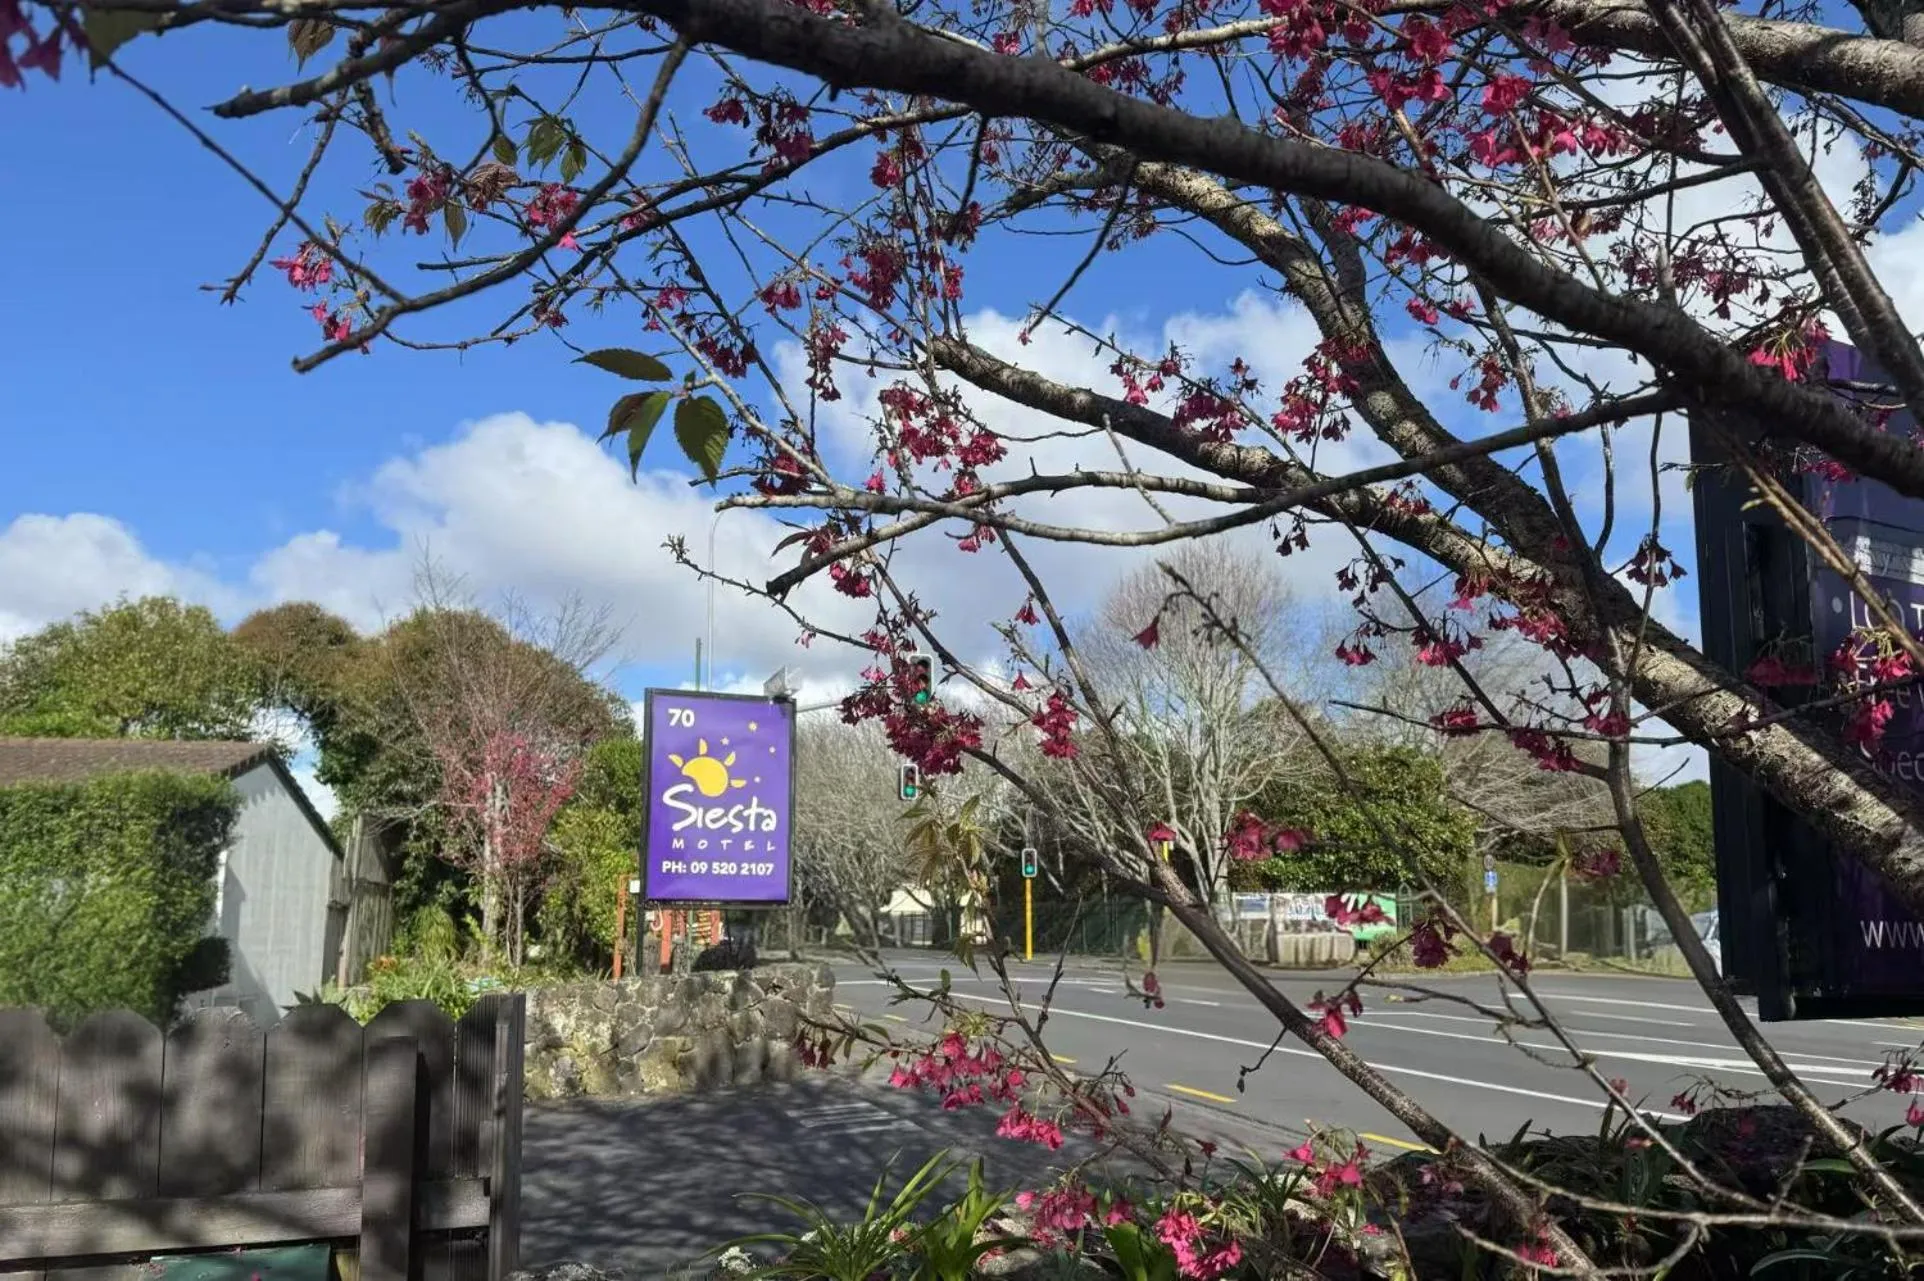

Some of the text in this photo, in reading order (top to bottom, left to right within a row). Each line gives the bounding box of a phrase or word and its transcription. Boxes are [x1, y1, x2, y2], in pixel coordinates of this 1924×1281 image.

[667, 708, 695, 728] 70
[662, 783, 777, 833] Siesta
[672, 838, 776, 852] MOTEL
[661, 860, 775, 876] PH: 09 520 2107
